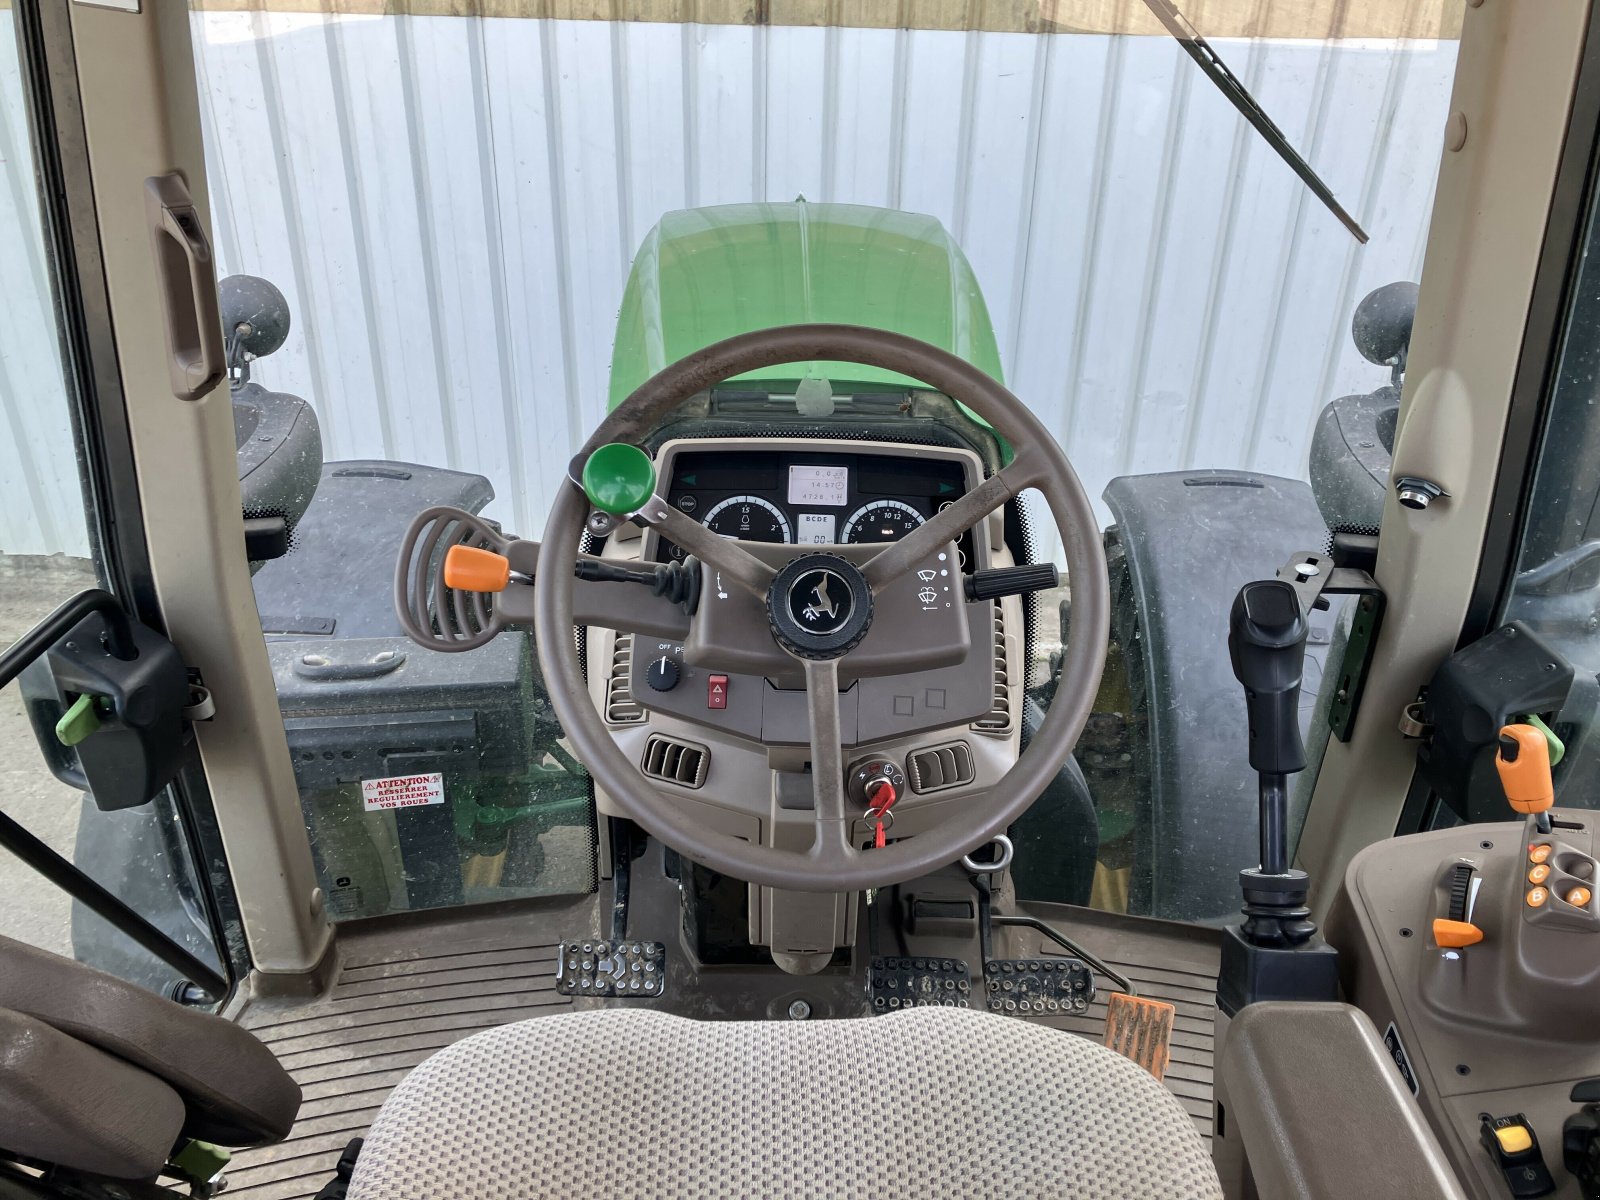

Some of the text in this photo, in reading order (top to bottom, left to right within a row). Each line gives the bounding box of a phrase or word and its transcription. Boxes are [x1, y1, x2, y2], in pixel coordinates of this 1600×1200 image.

[376, 776, 430, 789] ATTENTION
[378, 785, 428, 796] RESSERRER
[367, 791, 440, 804] REGULIEREMENT
[400, 798, 429, 807] ROUES
[1533, 867, 1544, 878] C
[1532, 890, 1543, 902] B
[1570, 890, 1583, 902] A
[1496, 1117, 1511, 1127] ON
